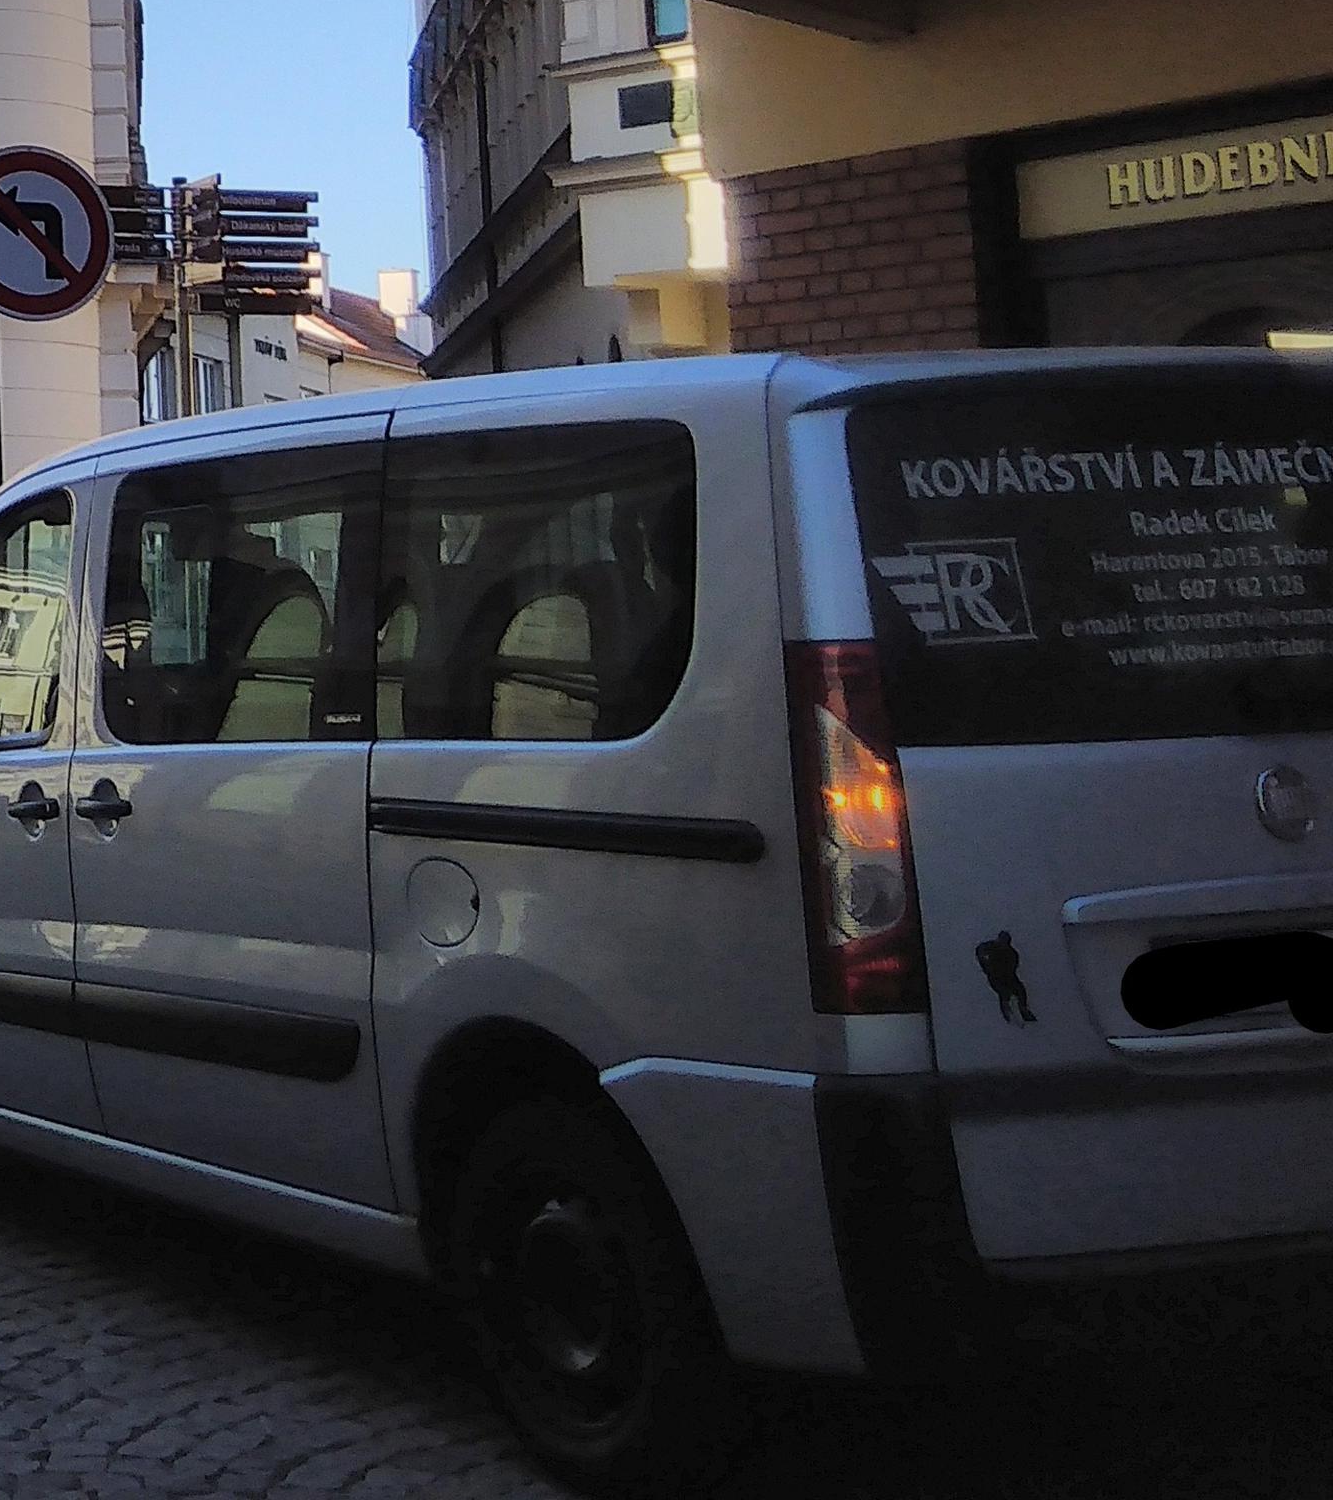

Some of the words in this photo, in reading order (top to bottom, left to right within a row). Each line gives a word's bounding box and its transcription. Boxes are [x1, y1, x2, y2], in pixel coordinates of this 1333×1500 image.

[225, 298, 242, 309] WC
[899, 444, 1141, 498] KOVÁŘSTVÍ
[1153, 450, 1180, 488] A
[1129, 508, 1212, 537] Radek
